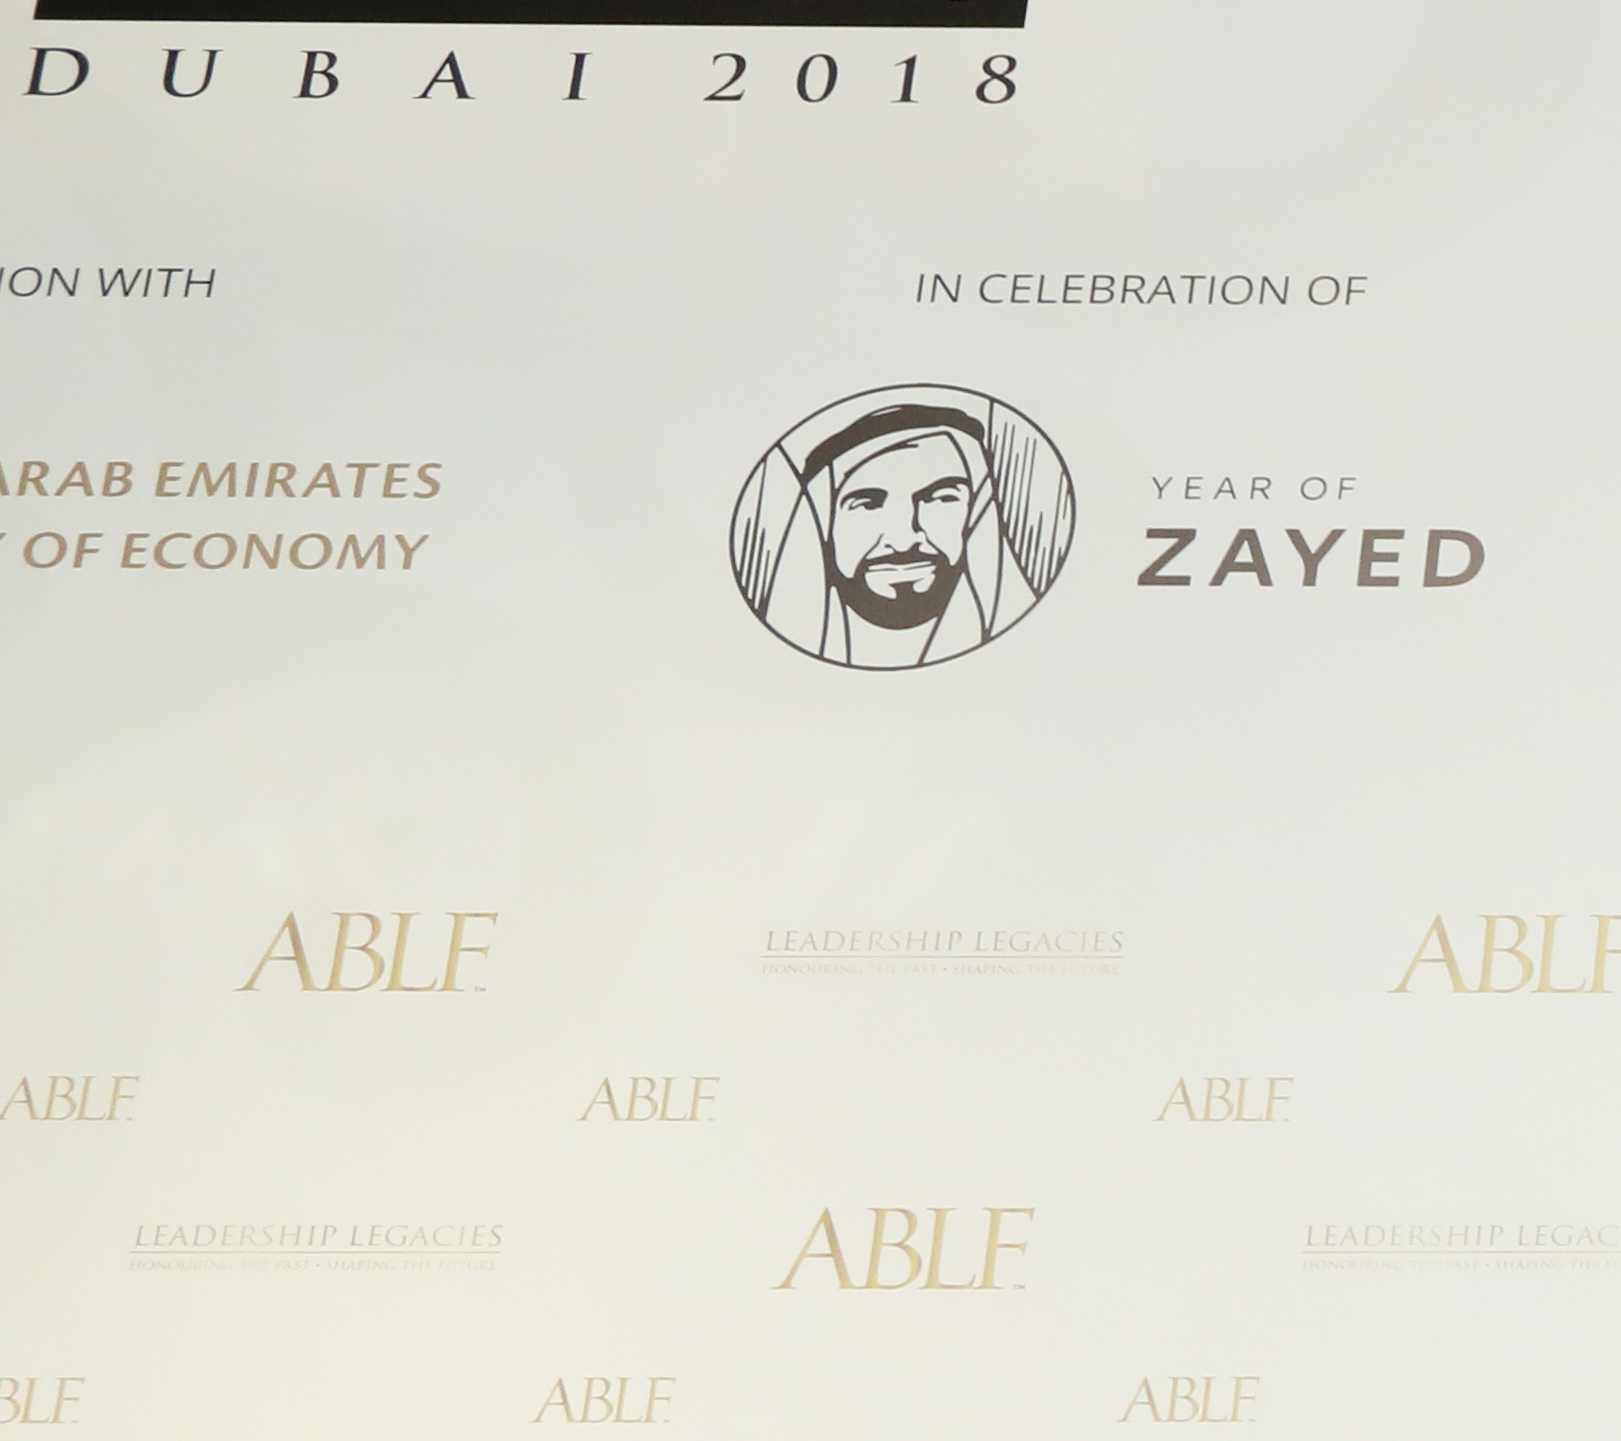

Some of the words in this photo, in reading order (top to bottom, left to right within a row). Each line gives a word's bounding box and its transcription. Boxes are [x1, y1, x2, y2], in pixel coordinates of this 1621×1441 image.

[25, 45, 590, 103] DUBAI
[703, 52, 1021, 107] 2018
[98, 267, 216, 298] WITH
[914, 272, 964, 306] IN
[978, 272, 1289, 307] CELEBRATION
[1306, 274, 1369, 307] OF
[155, 462, 442, 499] EMIRATES
[1150, 475, 1272, 502] YEAR
[1300, 476, 1358, 502] OF
[23, 532, 102, 569] OF
[120, 533, 430, 571] ECONOMY
[1137, 528, 1488, 590] ZAYED
[235, 912, 498, 992] ABLF
[766, 930, 962, 951] LEADERSHIP
[975, 931, 1123, 952] LEGACIES
[0, 1076, 140, 1121] ABLF
[578, 1077, 720, 1121] ABLF
[1155, 1077, 1294, 1122] ABLF
[135, 1224, 337, 1246] LEADERSHIP
[350, 1224, 503, 1247] LEGACIES
[772, 1208, 1034, 1290] ABLF
[1306, 1224, 1504, 1247] LEADERSHIP
[130, 1260, 233, 1271] HONOURING
[326, 1260, 395, 1271] SHAPING
[0, 1377, 85, 1423] BLF
[530, 1377, 676, 1423] ABLF
[1118, 1376, 1260, 1423] ABLF
